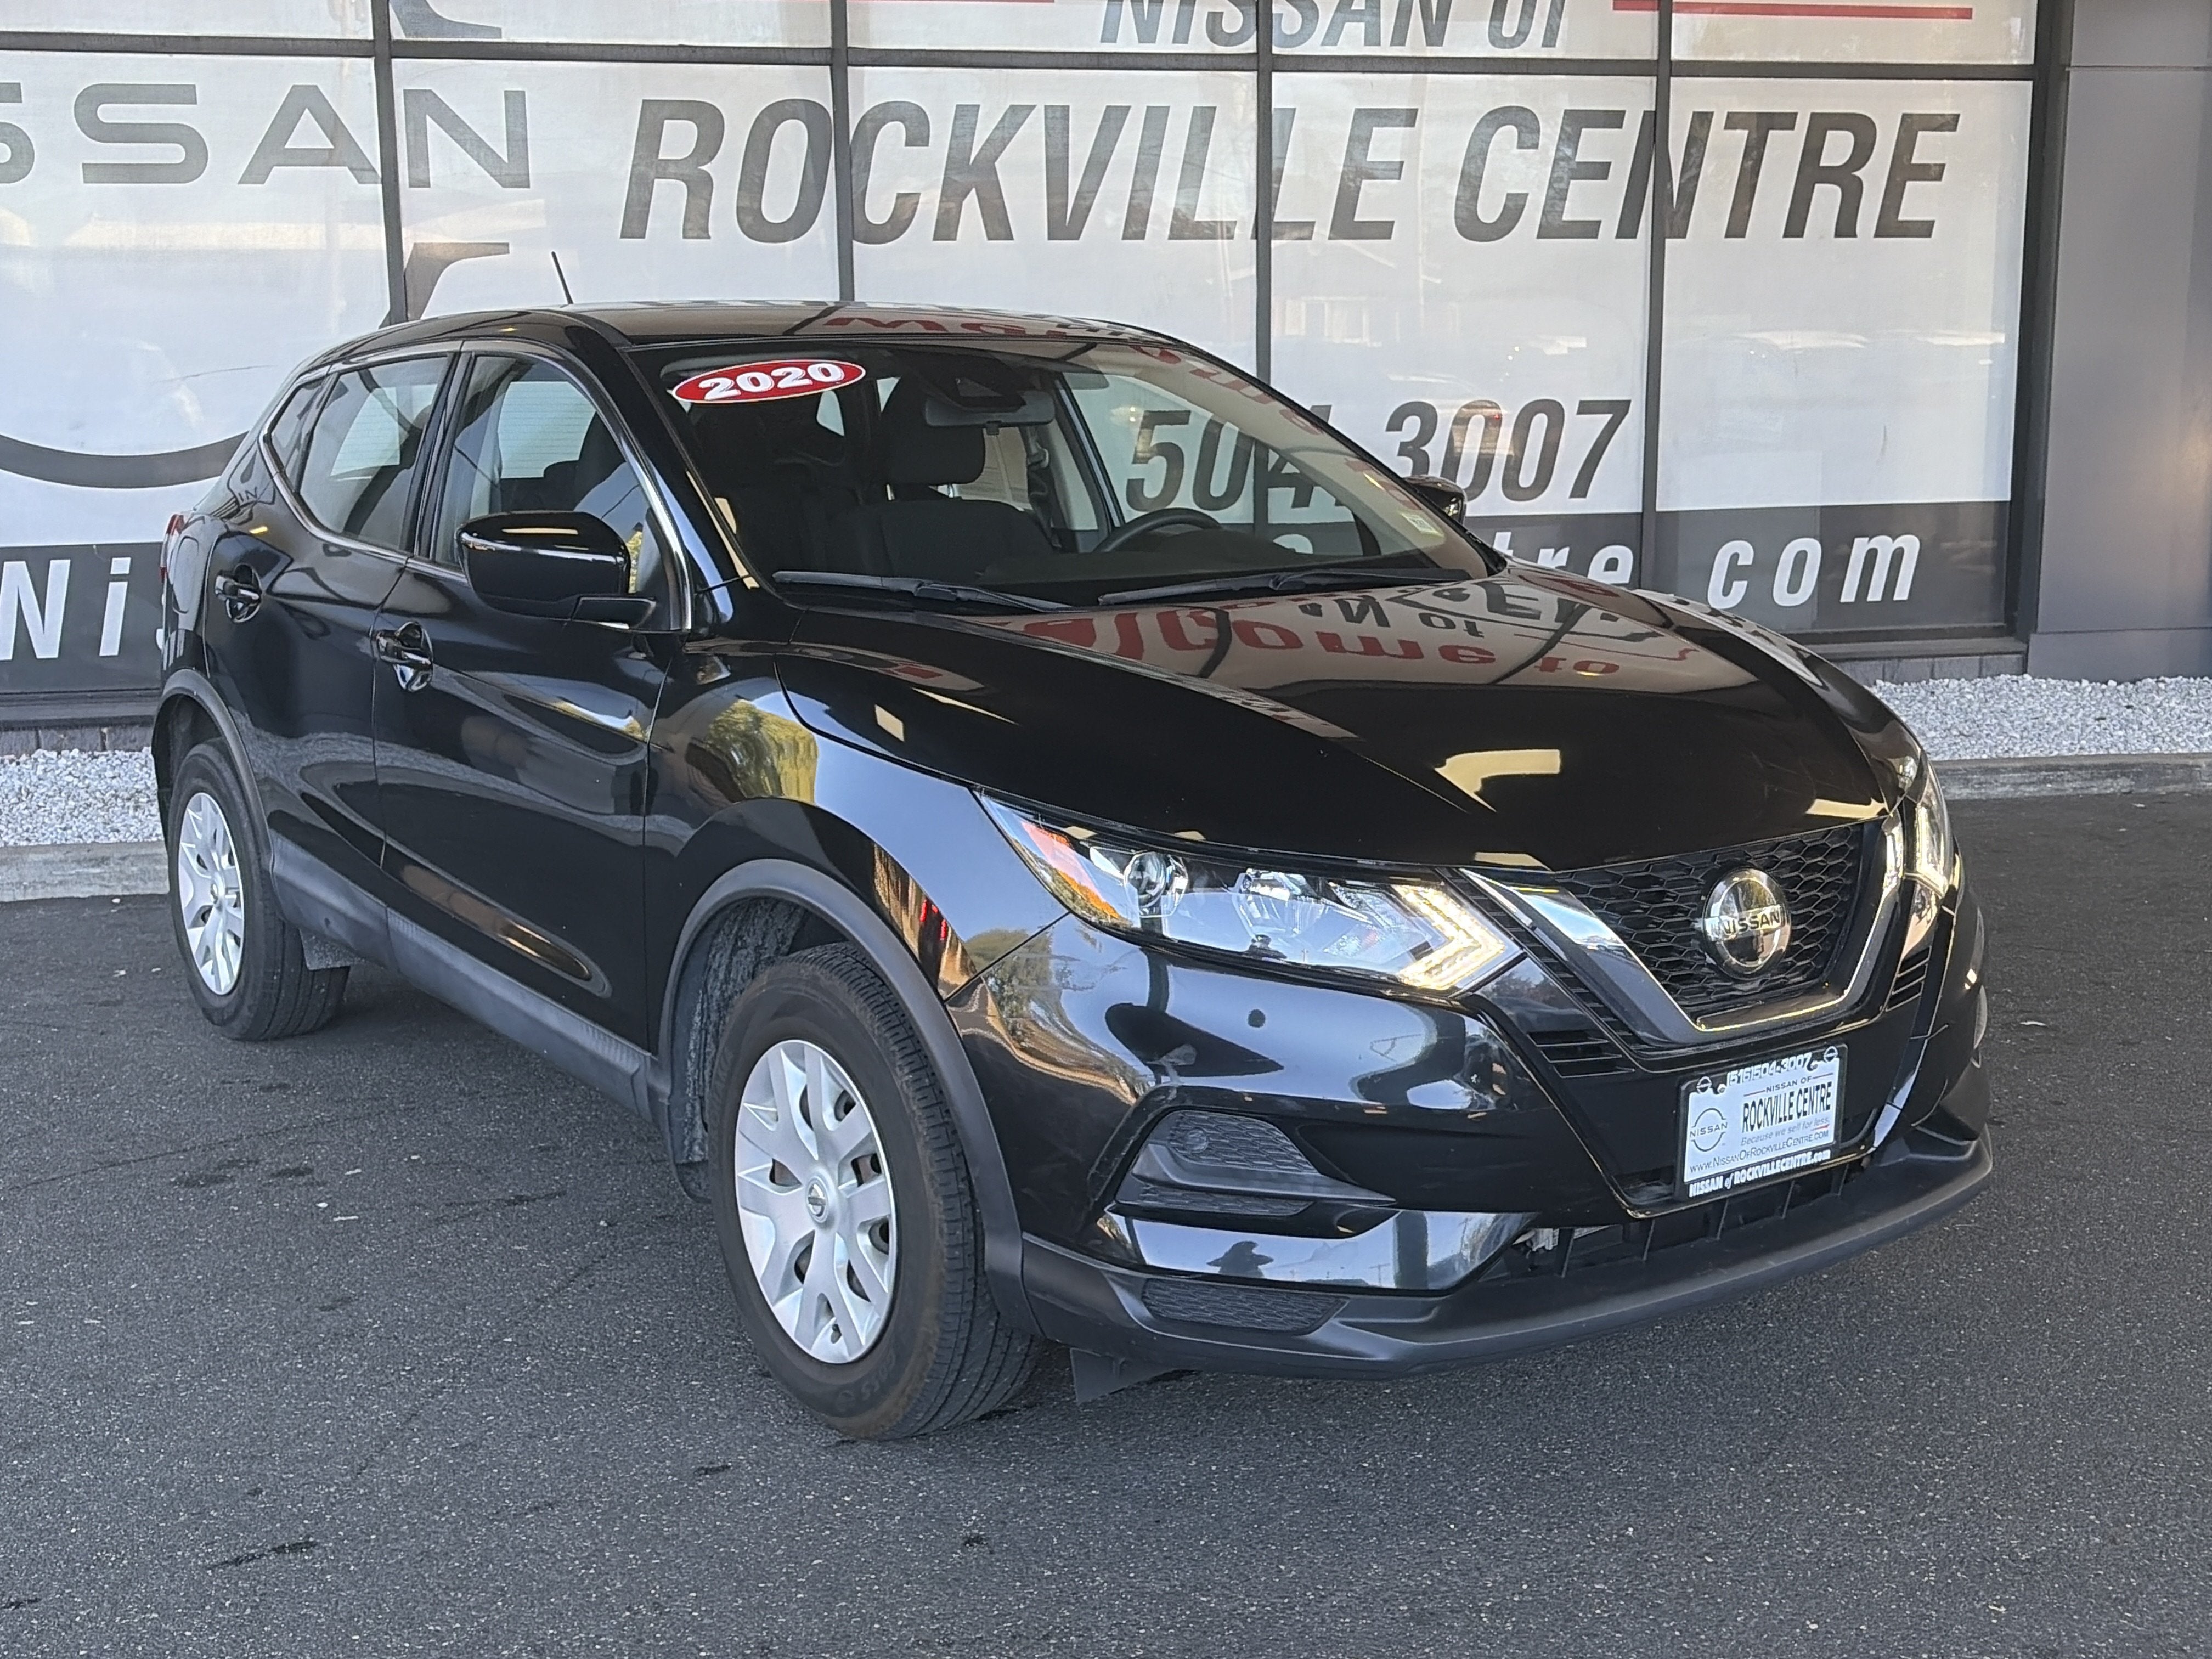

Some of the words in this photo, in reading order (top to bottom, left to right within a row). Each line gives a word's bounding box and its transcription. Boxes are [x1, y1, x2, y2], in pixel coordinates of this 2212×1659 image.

[0, 82, 531, 188] SAN
[619, 99, 1418, 244] ROCKVILLE
[1454, 105, 1960, 242] CENTRE
[698, 363, 845, 400] 2020
[1723, 910, 1780, 934] NISSAN
[1766, 1079, 1798, 1093] NISSAN
[1800, 1076, 1812, 1084] OF
[1742, 1091, 1795, 1133] ROCKVILLE
[1796, 1081, 1832, 1119] CENTRE
[1690, 1121, 1728, 1138] NISSAN
[1740, 1131, 1773, 1146] Because
[1775, 1128, 1786, 1137] we
[1689, 1175, 1723, 1197] NISSAN
